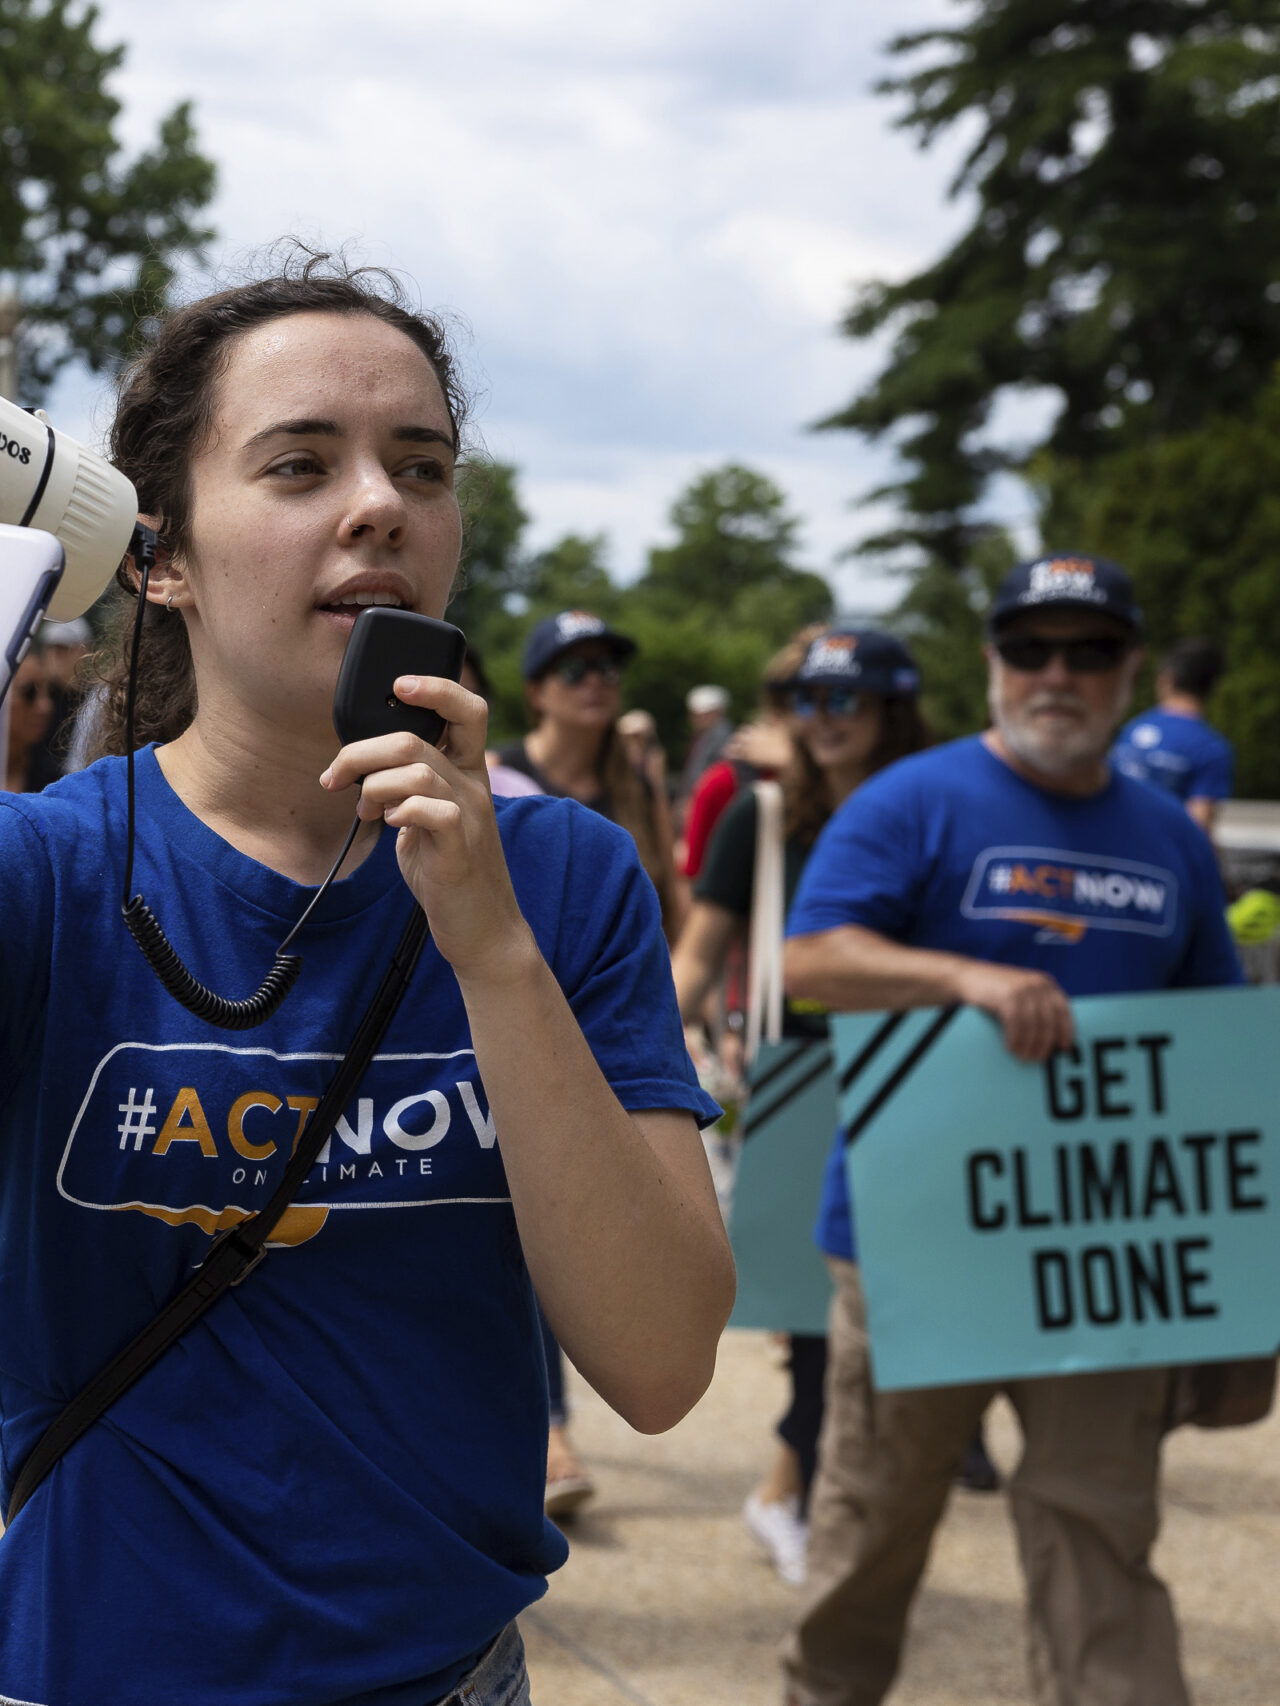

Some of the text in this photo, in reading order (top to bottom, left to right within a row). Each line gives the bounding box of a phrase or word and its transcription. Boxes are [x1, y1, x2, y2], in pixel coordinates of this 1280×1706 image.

[987, 863, 1166, 915] #ACTNOW
[1046, 1032, 1173, 1122] GET
[232, 1157, 433, 1185] ON IMATE
[966, 1127, 1267, 1232] CLIMATE
[1032, 1236, 1219, 1333] DONE
